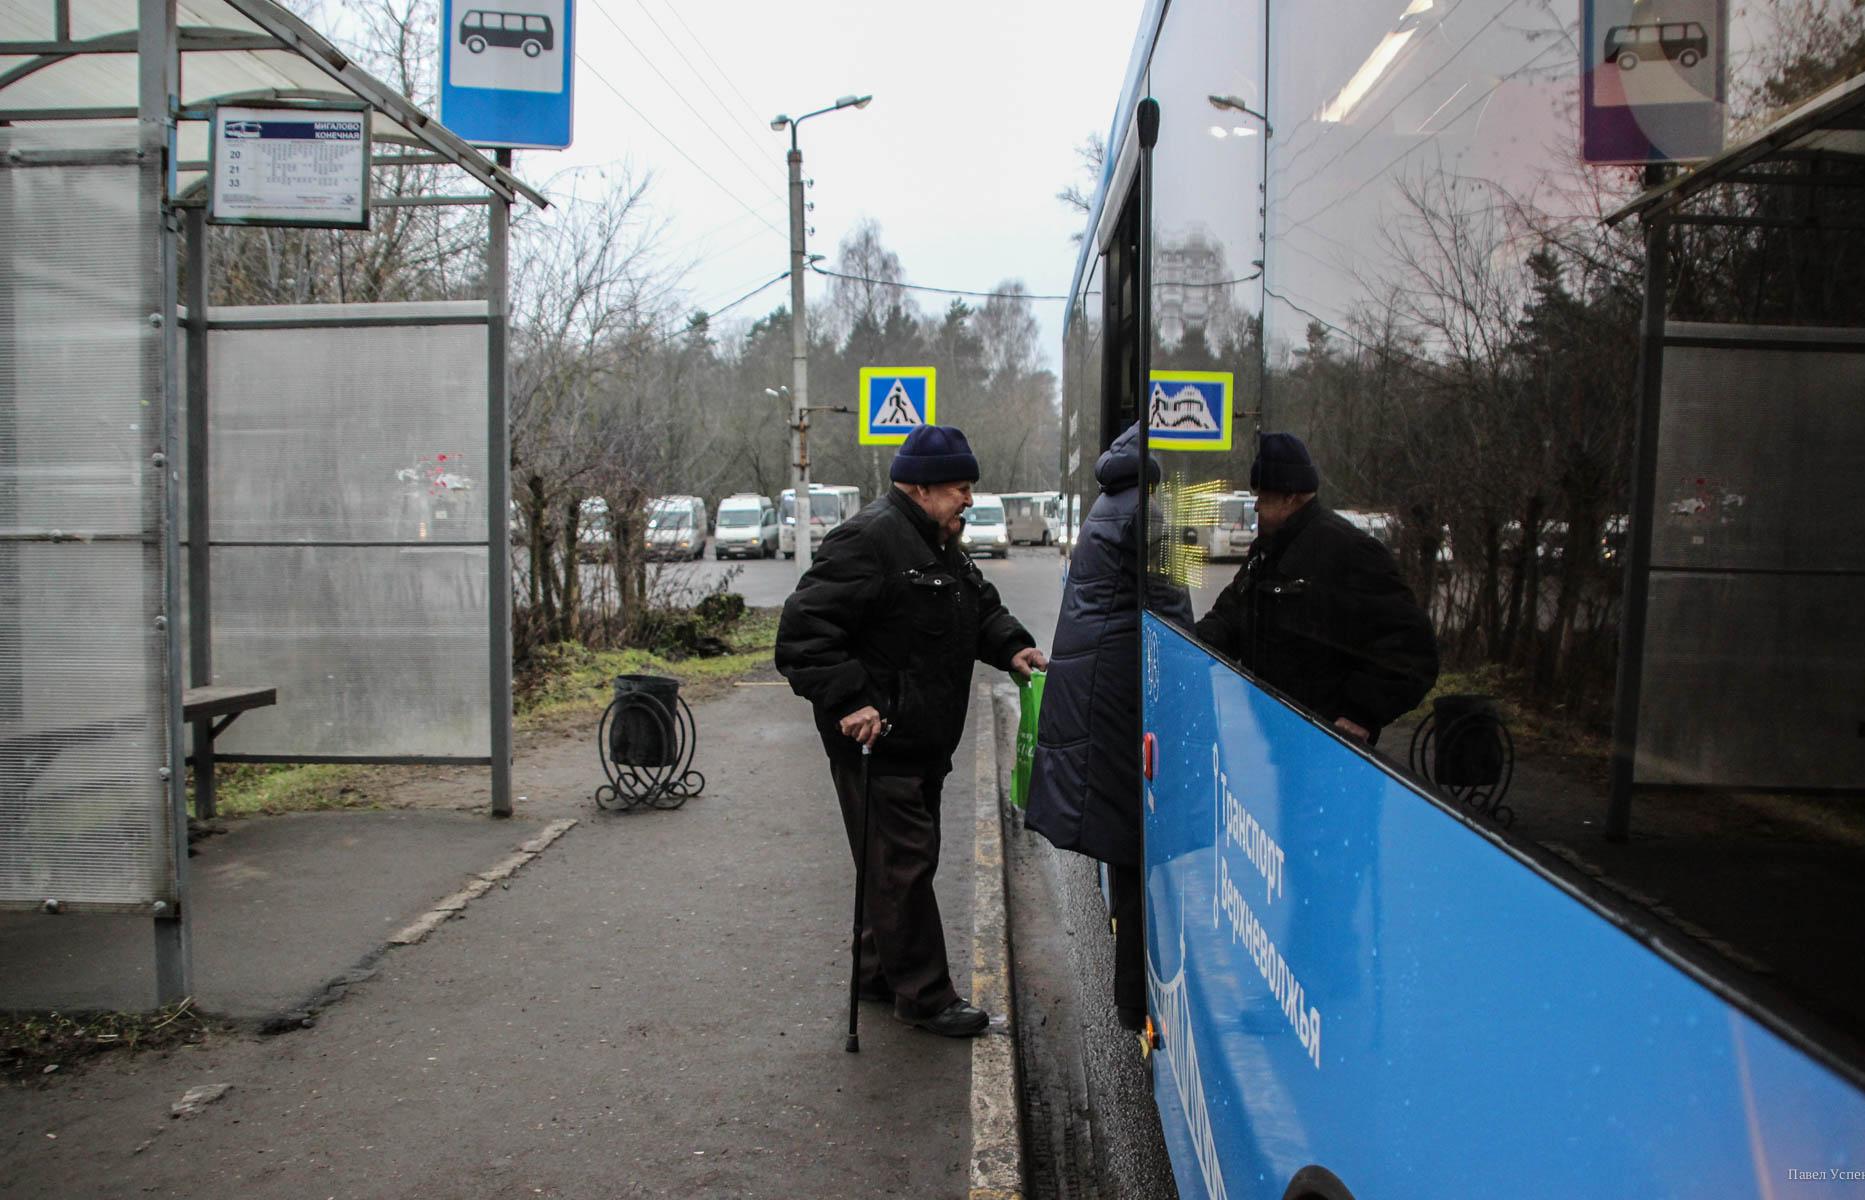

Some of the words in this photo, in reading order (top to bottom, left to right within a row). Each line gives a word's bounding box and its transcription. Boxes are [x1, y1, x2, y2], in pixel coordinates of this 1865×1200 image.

[314, 122, 360, 130] МИГАЛОВО
[315, 131, 361, 139] КОНЕЧНАЯ
[230, 151, 241, 159] 20
[229, 166, 240, 174] 21
[228, 179, 240, 188] 33
[1220, 771, 1285, 905] Транспорт
[1221, 855, 1321, 1070] Верхневолжья
